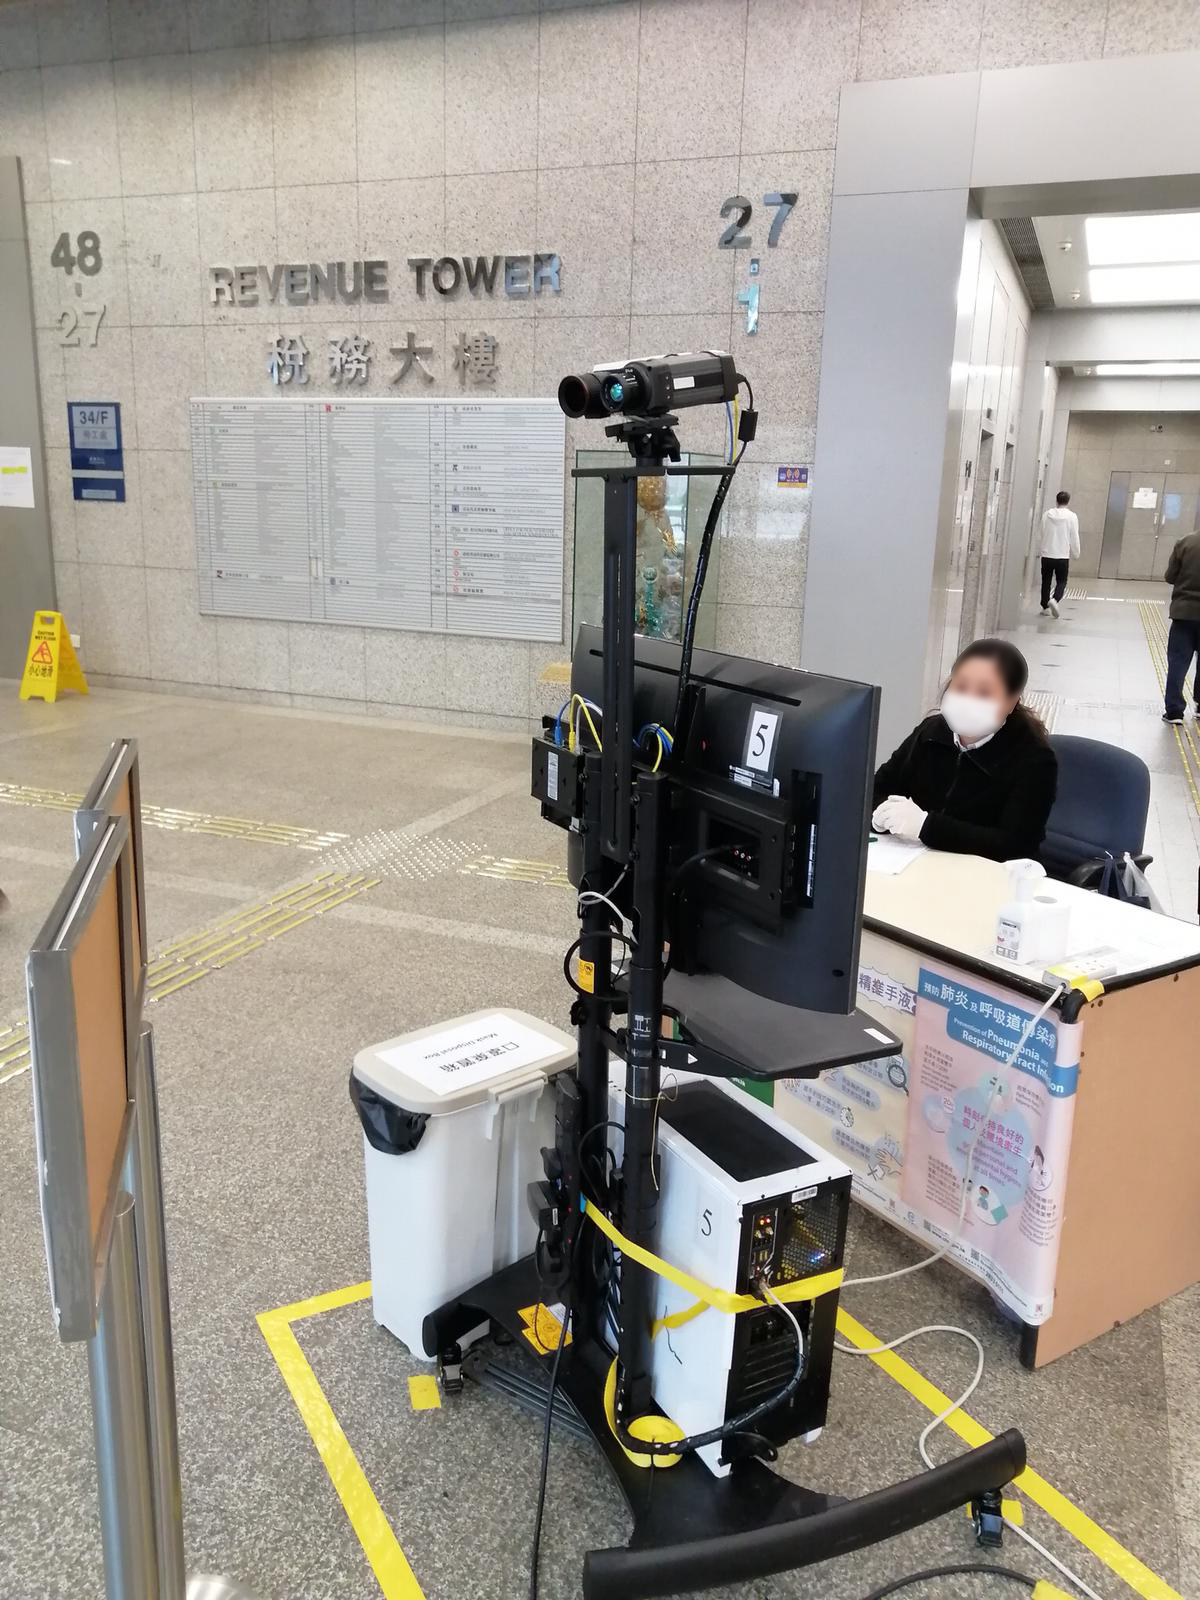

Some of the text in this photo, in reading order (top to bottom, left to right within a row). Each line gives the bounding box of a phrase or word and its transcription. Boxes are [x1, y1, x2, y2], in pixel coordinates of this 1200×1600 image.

[718, 192, 799, 249] 27
[51, 231, 102, 276] 48
[209, 253, 562, 308] REVENUE TOWER
[56, 304, 107, 348] 27
[737, 283, 760, 336] 1
[80, 410, 109, 425] 34/F
[752, 723, 769, 757] 5
[953, 1016, 982, 1035] Prevention
[988, 1029, 1040, 1061] Pneumonia
[962, 1029, 1011, 1062] Respiratory
[701, 1208, 713, 1237] 5
